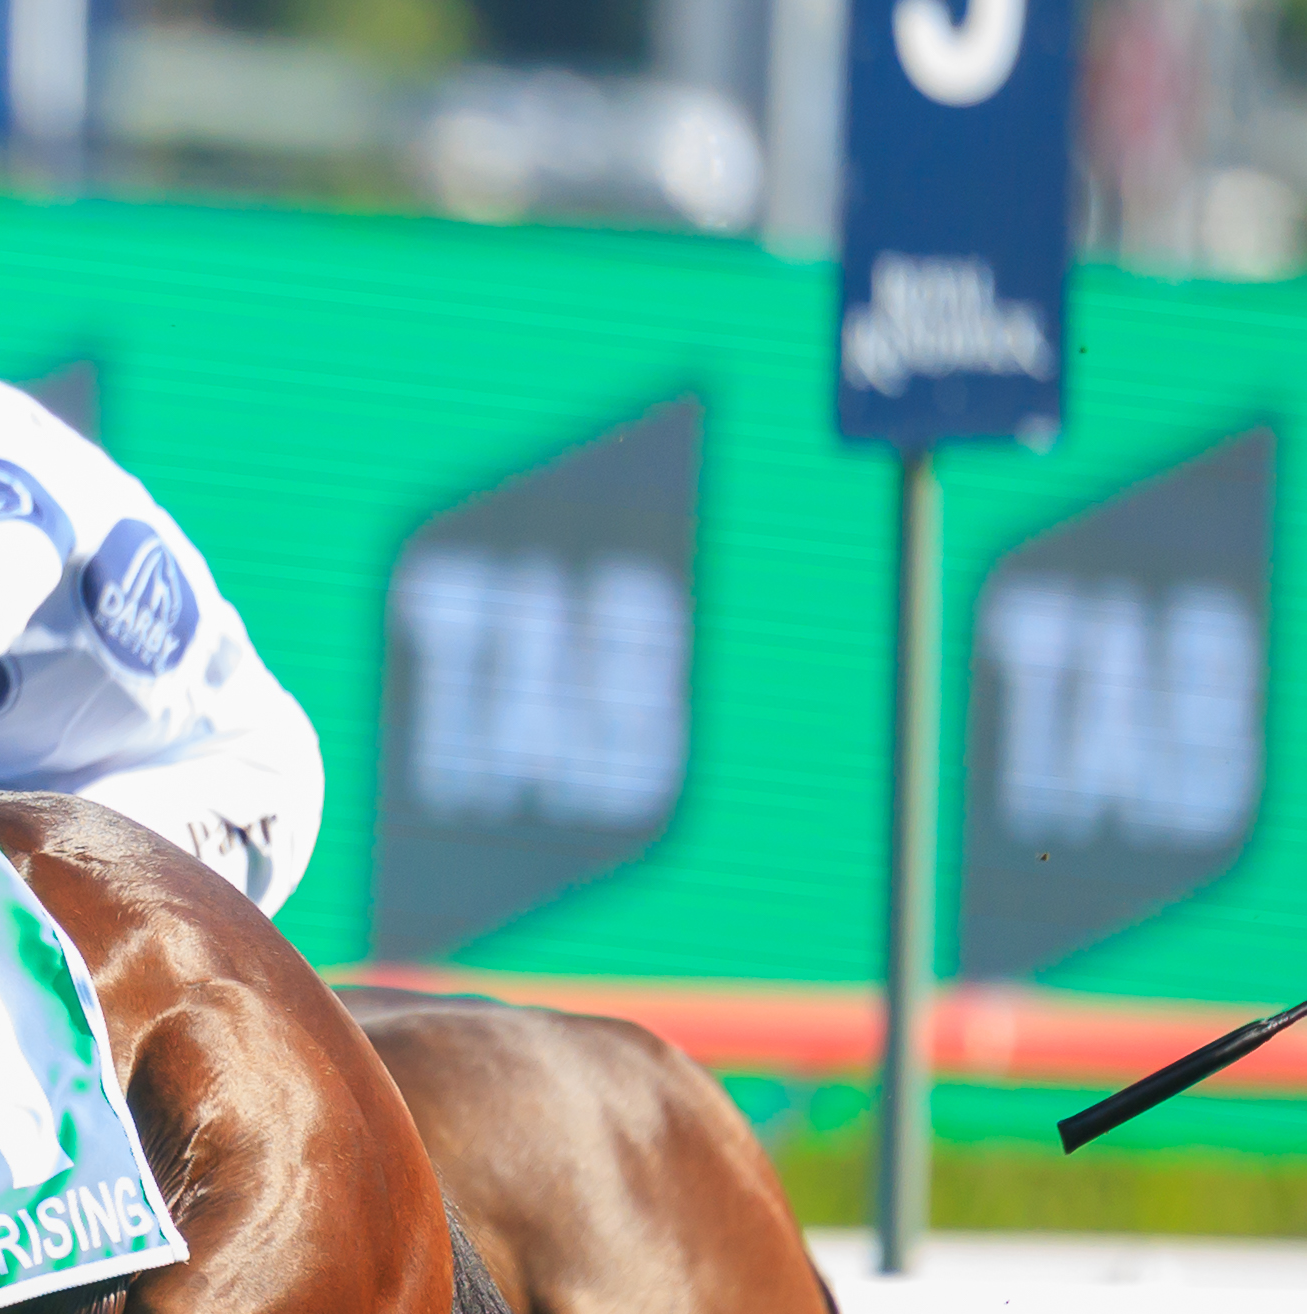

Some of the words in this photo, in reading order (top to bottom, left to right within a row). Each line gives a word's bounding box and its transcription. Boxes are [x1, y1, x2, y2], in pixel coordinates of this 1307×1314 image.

[99, 581, 181, 664] DARBY
[397, 554, 684, 816] TAB
[989, 584, 1257, 836] TAB
